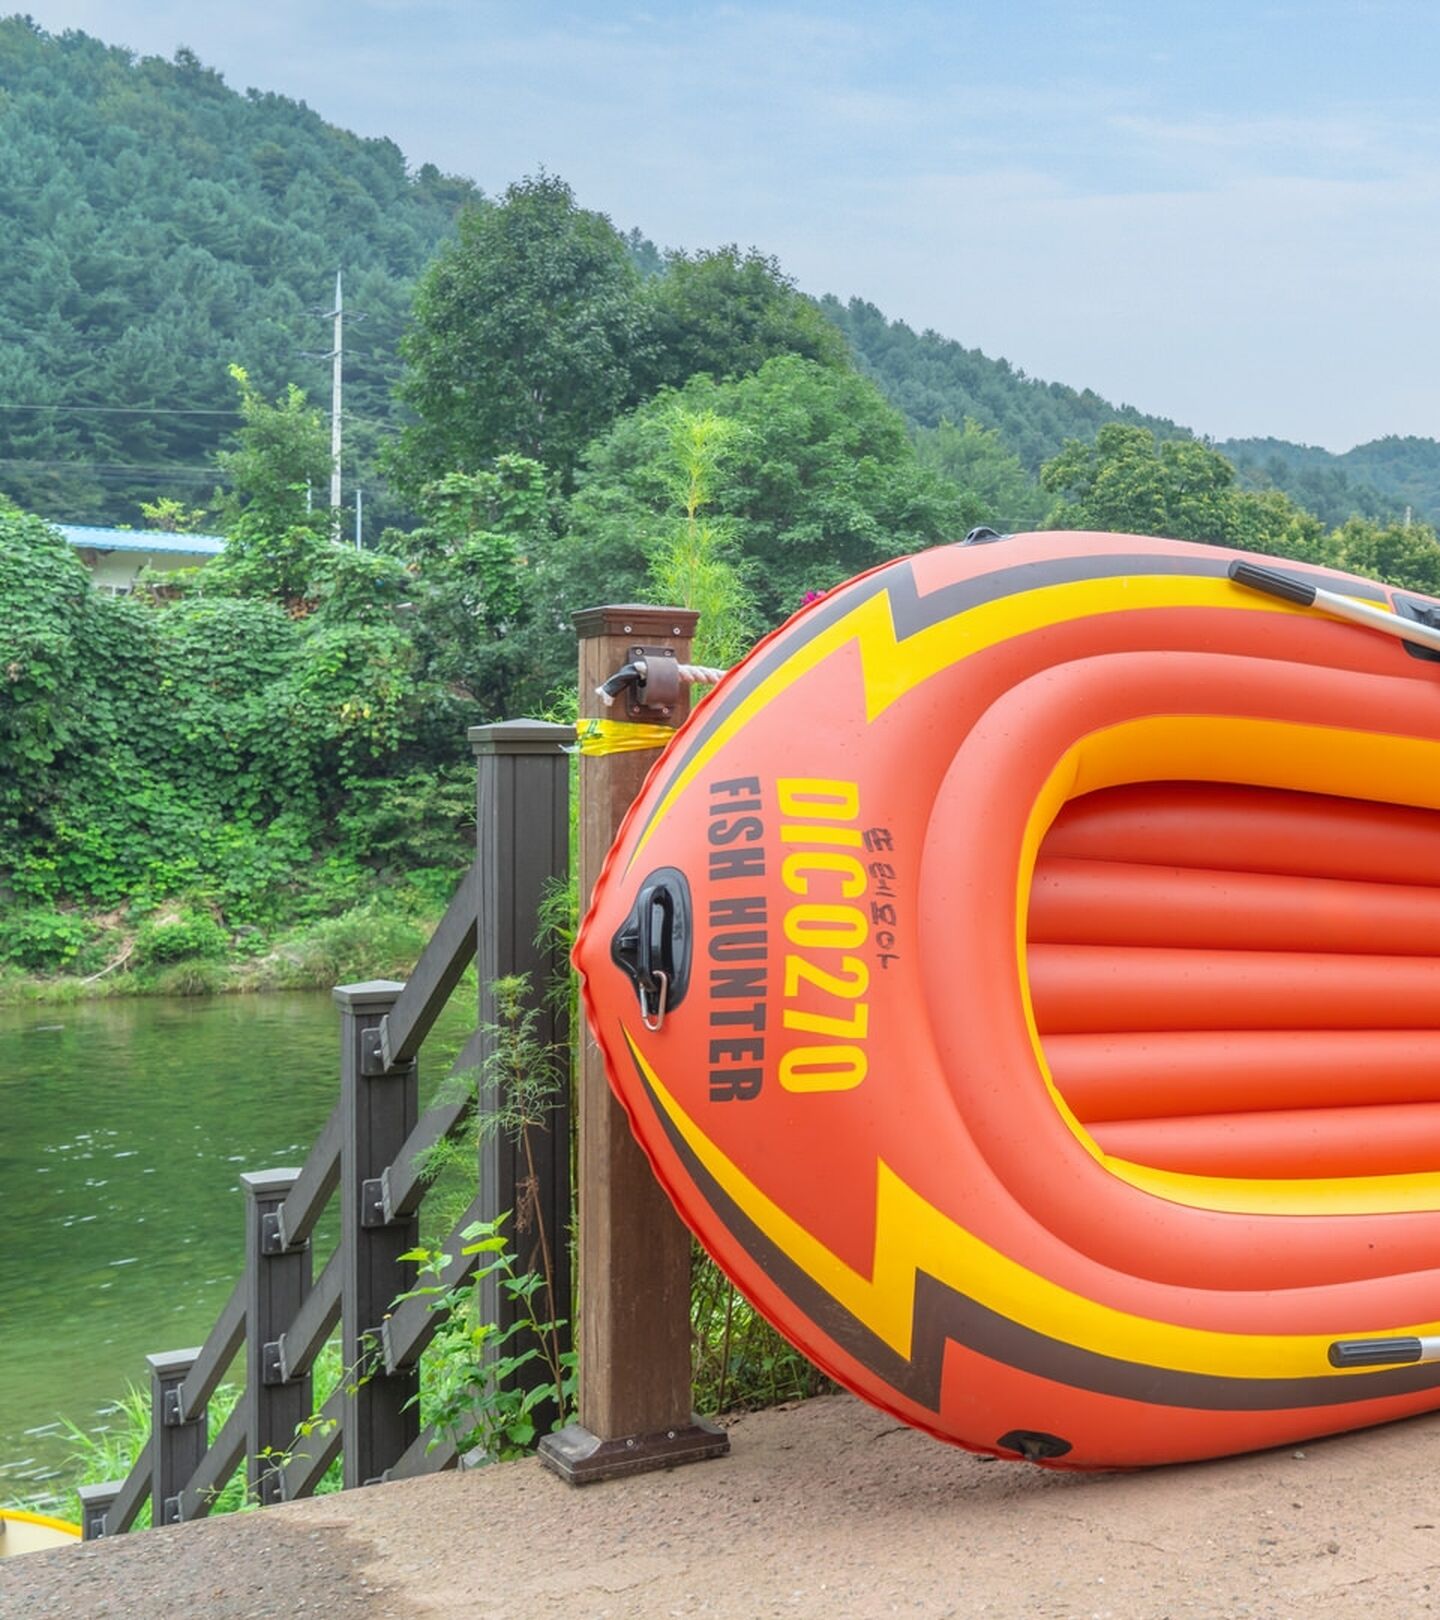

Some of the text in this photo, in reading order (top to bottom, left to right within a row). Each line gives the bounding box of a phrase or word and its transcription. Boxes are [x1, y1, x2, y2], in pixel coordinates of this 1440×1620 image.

[708, 777, 767, 1101] FISH HUNTER
[776, 777, 869, 1093] DICO270
